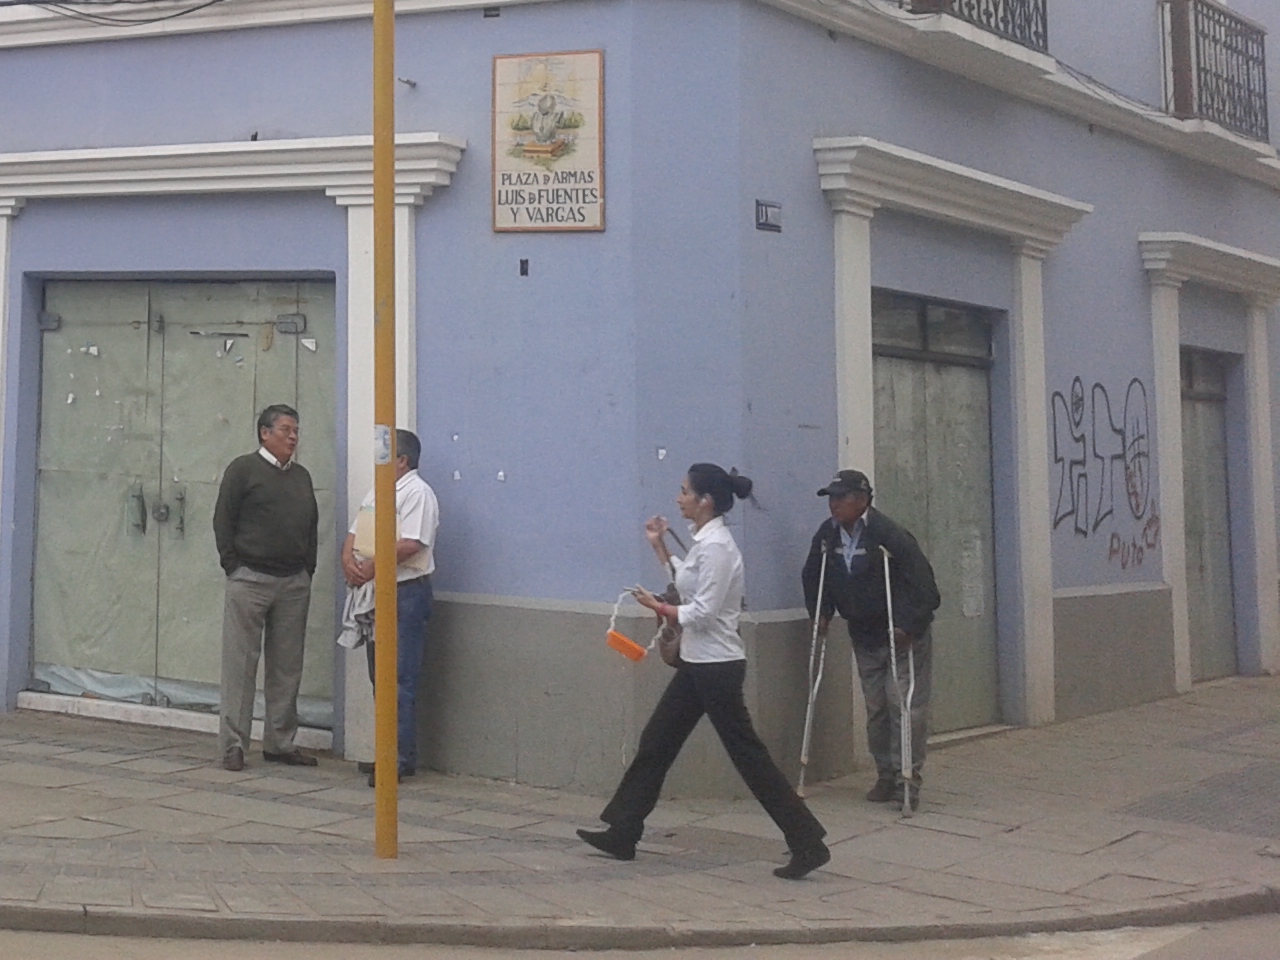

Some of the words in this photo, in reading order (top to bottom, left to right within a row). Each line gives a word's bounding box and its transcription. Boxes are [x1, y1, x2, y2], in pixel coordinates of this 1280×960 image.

[501, 172, 539, 186] PLAZA
[552, 170, 595, 185] ARMAS
[497, 189, 526, 206] LUIS
[537, 187, 598, 205] FUENTES
[510, 207, 520, 223] Y
[525, 206, 586, 223] VARGAS
